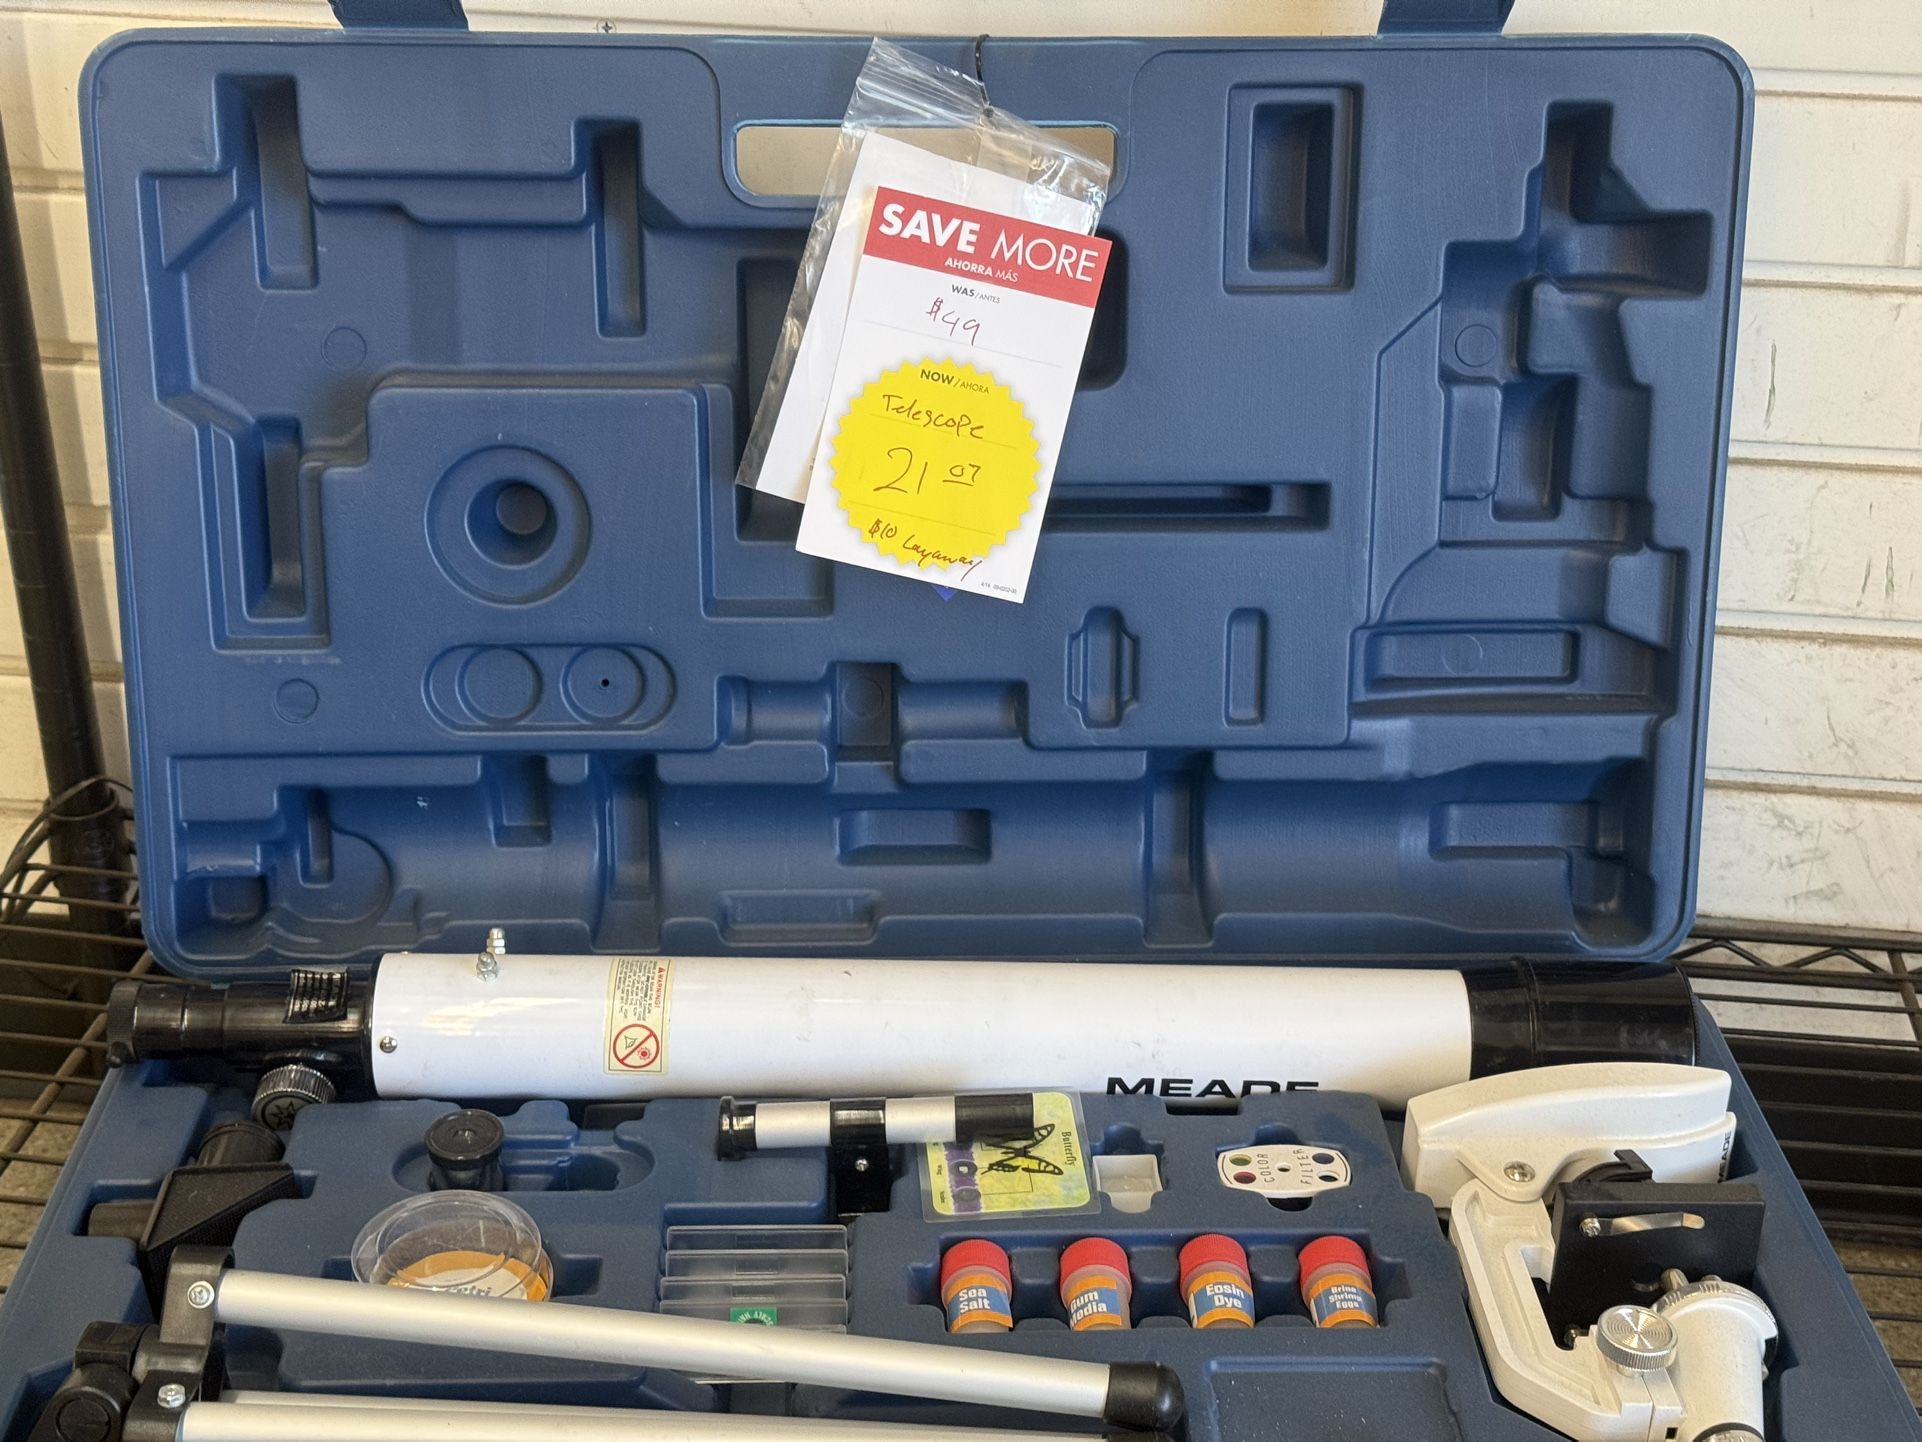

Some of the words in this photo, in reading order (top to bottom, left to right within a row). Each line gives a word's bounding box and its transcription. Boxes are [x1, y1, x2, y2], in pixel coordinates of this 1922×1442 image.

[878, 203, 981, 254] SAVE
[990, 229, 1099, 282] MORE
[944, 257, 993, 277] AHORRA
[995, 269, 1018, 282] MÁS
[926, 297, 981, 346] $49
[873, 447, 928, 494] 21
[868, 518, 897, 538] $10
[902, 535, 982, 581] Layaway
[1062, 1131, 1077, 1166] Butterfly
[1257, 1153, 1275, 1183] COLOR
[1293, 1148, 1314, 1185] FILTER
[958, 1288, 987, 1301] Sea
[959, 1298, 991, 1313] Salt
[1205, 1283, 1245, 1299] Eosin
[1213, 1294, 1242, 1308] Dye
